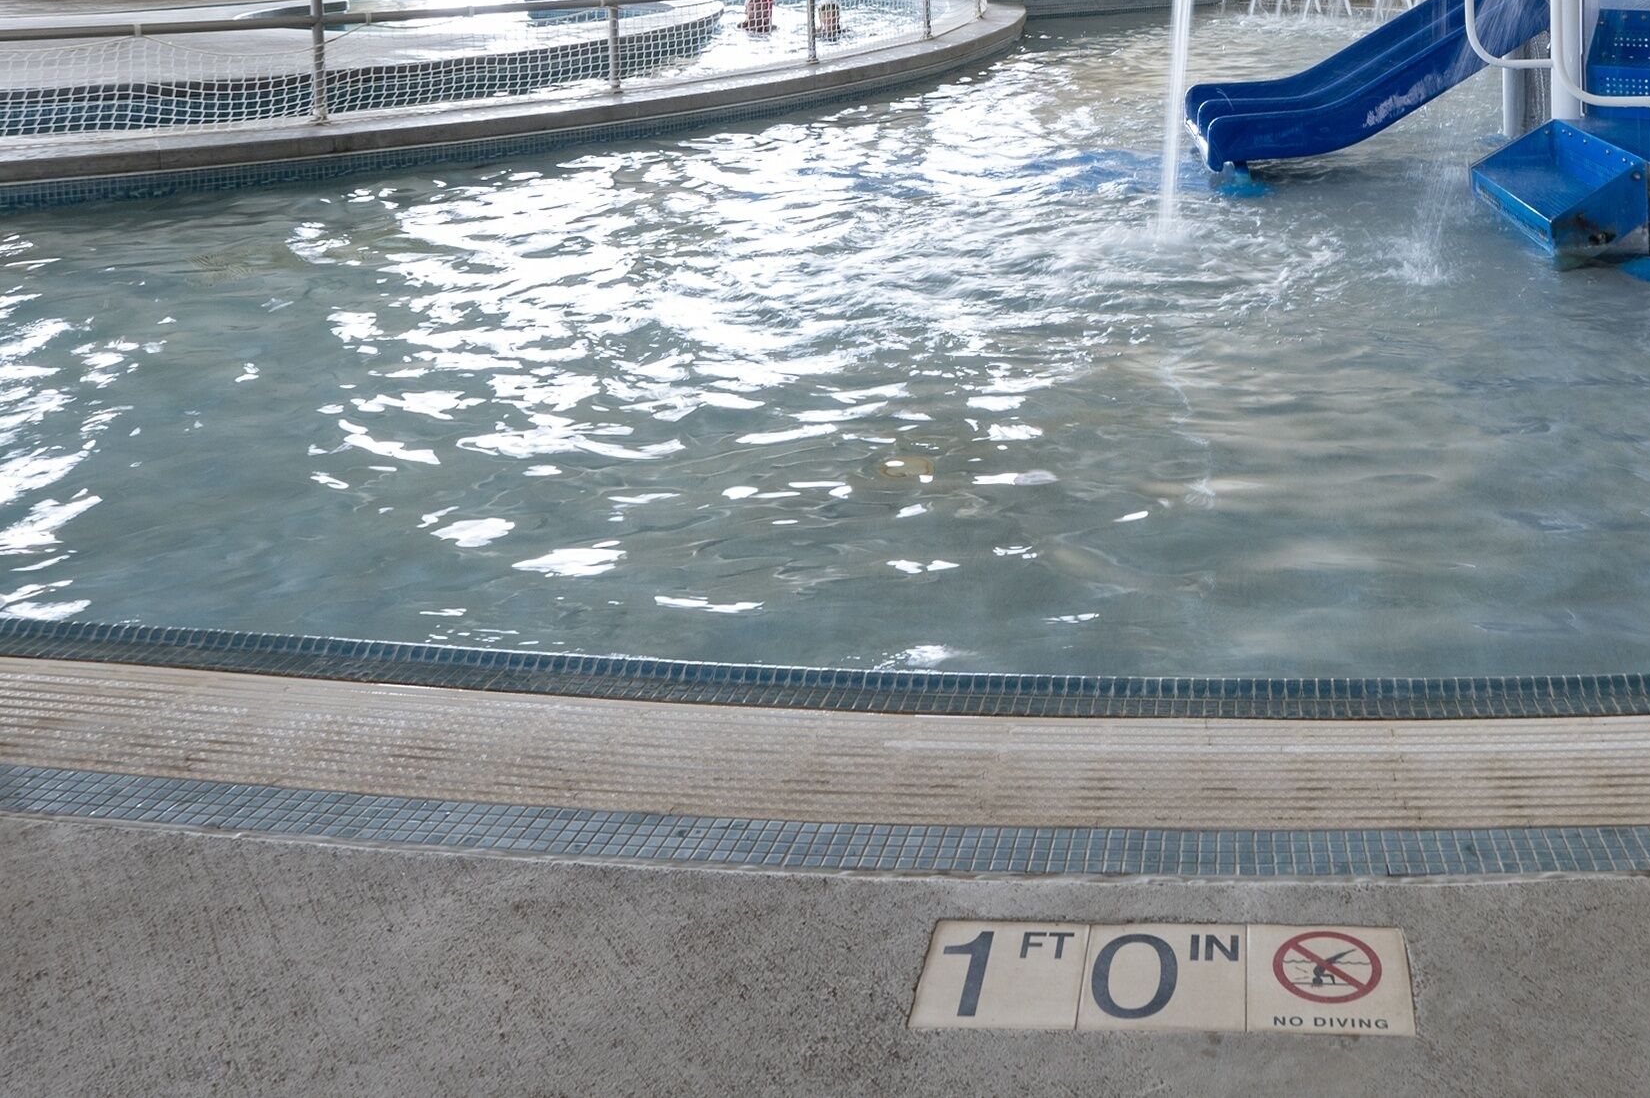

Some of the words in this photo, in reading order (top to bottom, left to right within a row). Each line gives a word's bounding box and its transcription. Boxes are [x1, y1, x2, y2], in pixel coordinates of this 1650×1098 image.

[942, 931, 995, 1017] 1
[1019, 932, 1075, 959] FT
[1091, 933, 1178, 1019] 0
[1189, 934, 1239, 961] IN
[1273, 1016, 1303, 1026] NO
[1313, 1017, 1389, 1029] DIVING
